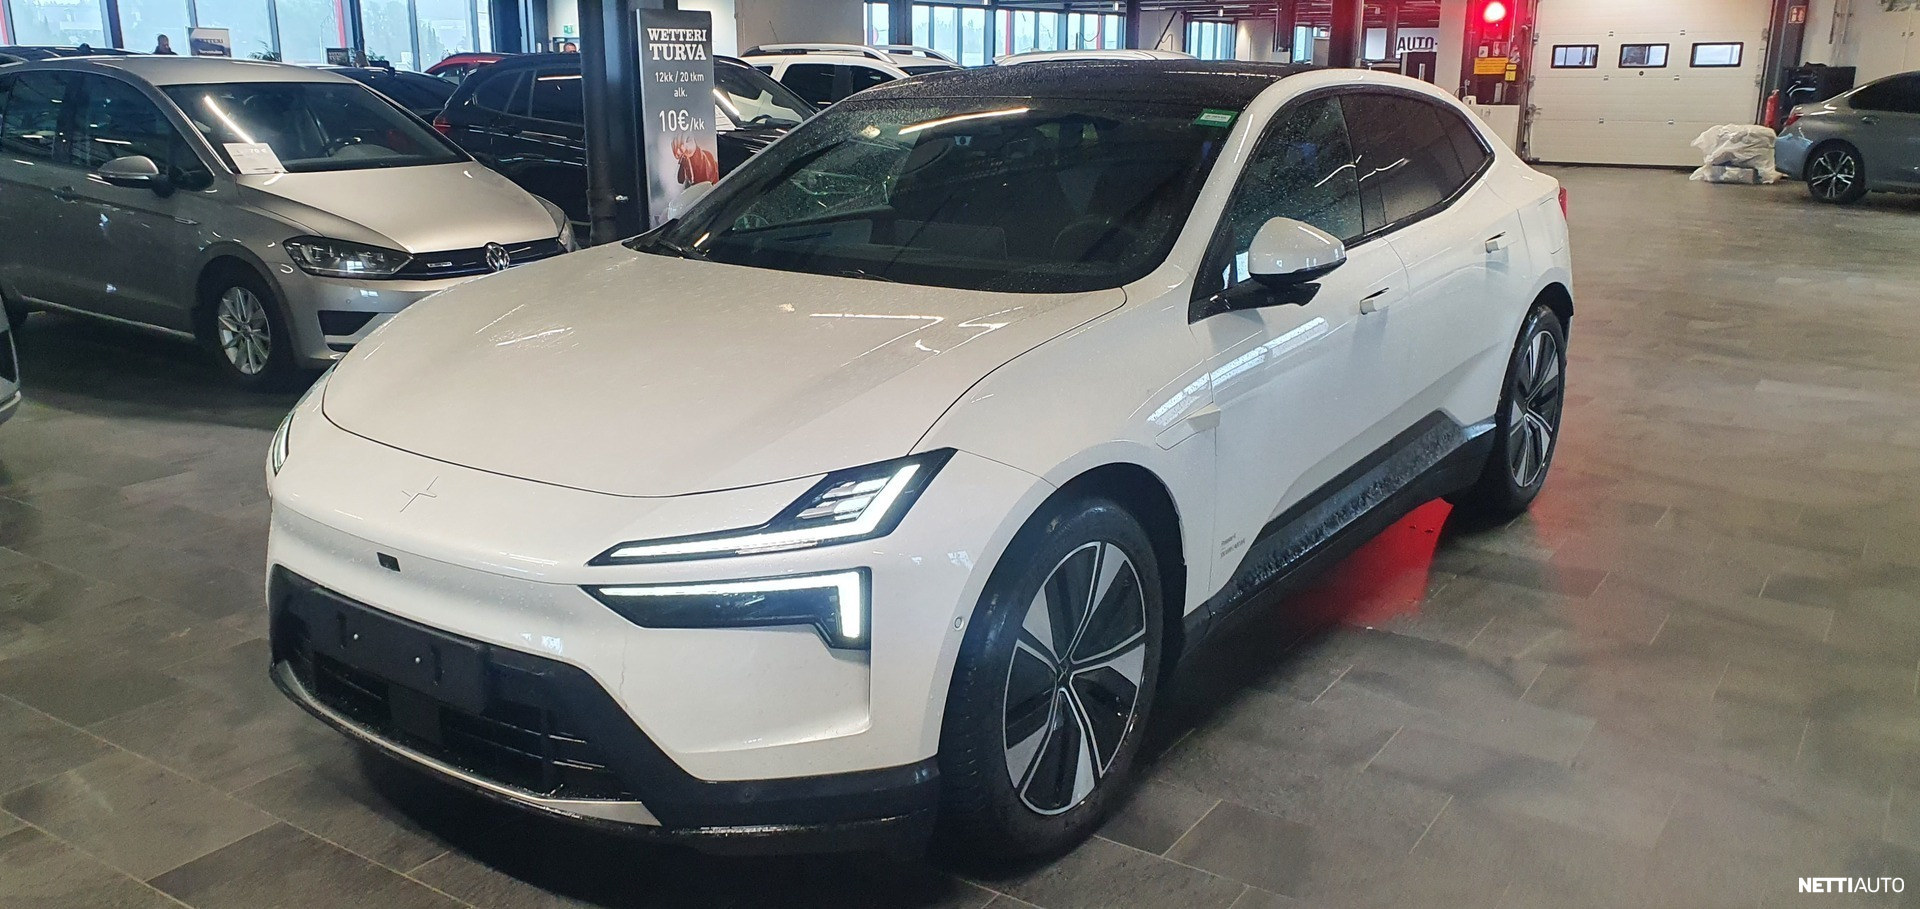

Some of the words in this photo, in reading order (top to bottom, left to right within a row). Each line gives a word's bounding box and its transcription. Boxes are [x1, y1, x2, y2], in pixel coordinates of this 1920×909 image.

[647, 28, 707, 42] WETTERI
[649, 43, 707, 61] TURVA
[655, 71, 674, 83] 12kk
[675, 71, 679, 83] /
[680, 72, 689, 82] 20
[690, 71, 704, 82] tkm
[673, 87, 688, 98] alk.
[659, 109, 705, 132] 10€/kk
